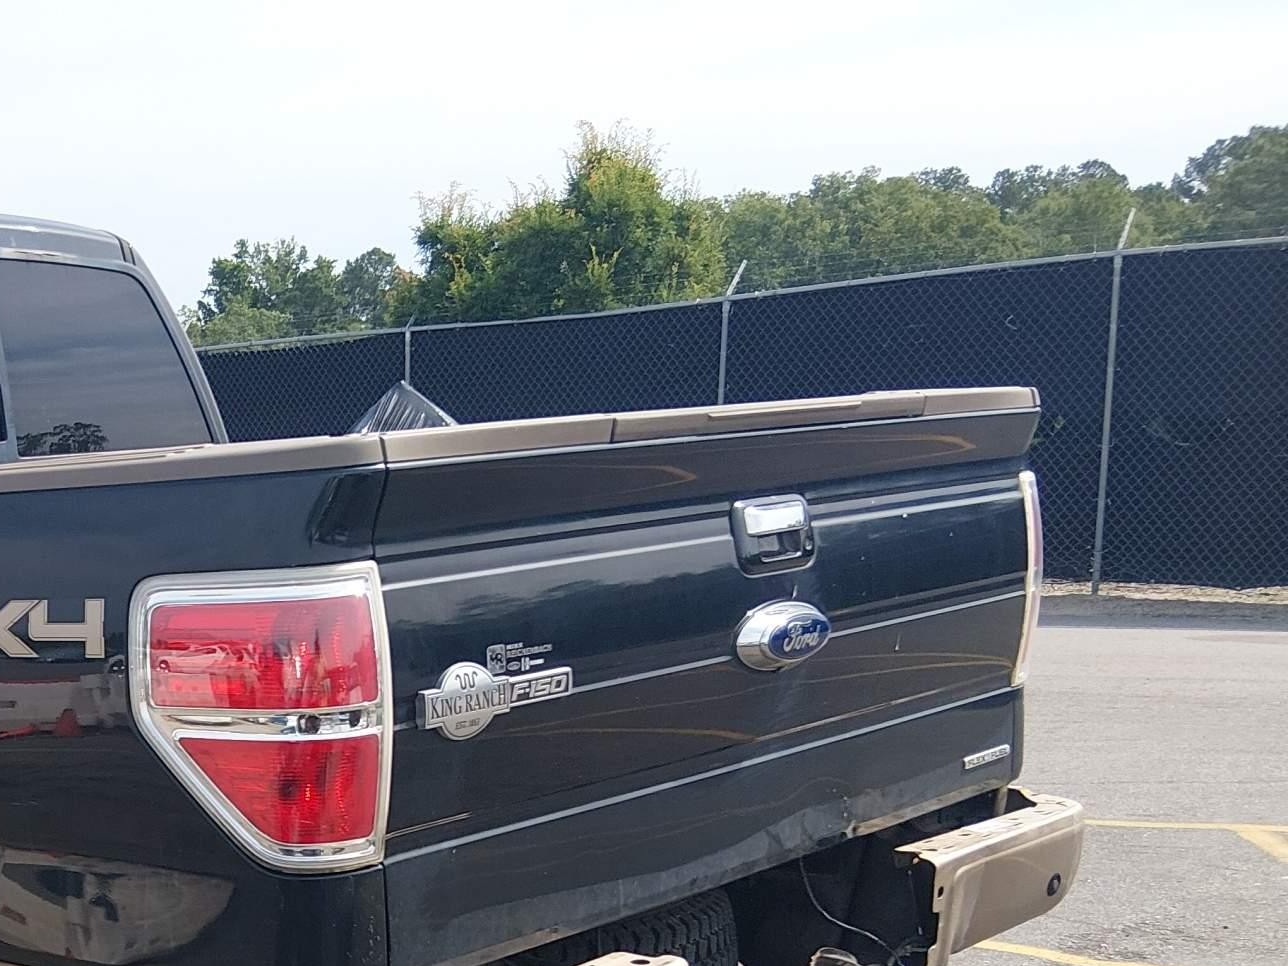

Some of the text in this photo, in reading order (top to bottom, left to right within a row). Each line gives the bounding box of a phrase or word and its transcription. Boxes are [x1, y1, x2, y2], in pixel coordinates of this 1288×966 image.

[783, 620, 822, 653] Ford
[430, 682, 508, 720] KING RANCH
